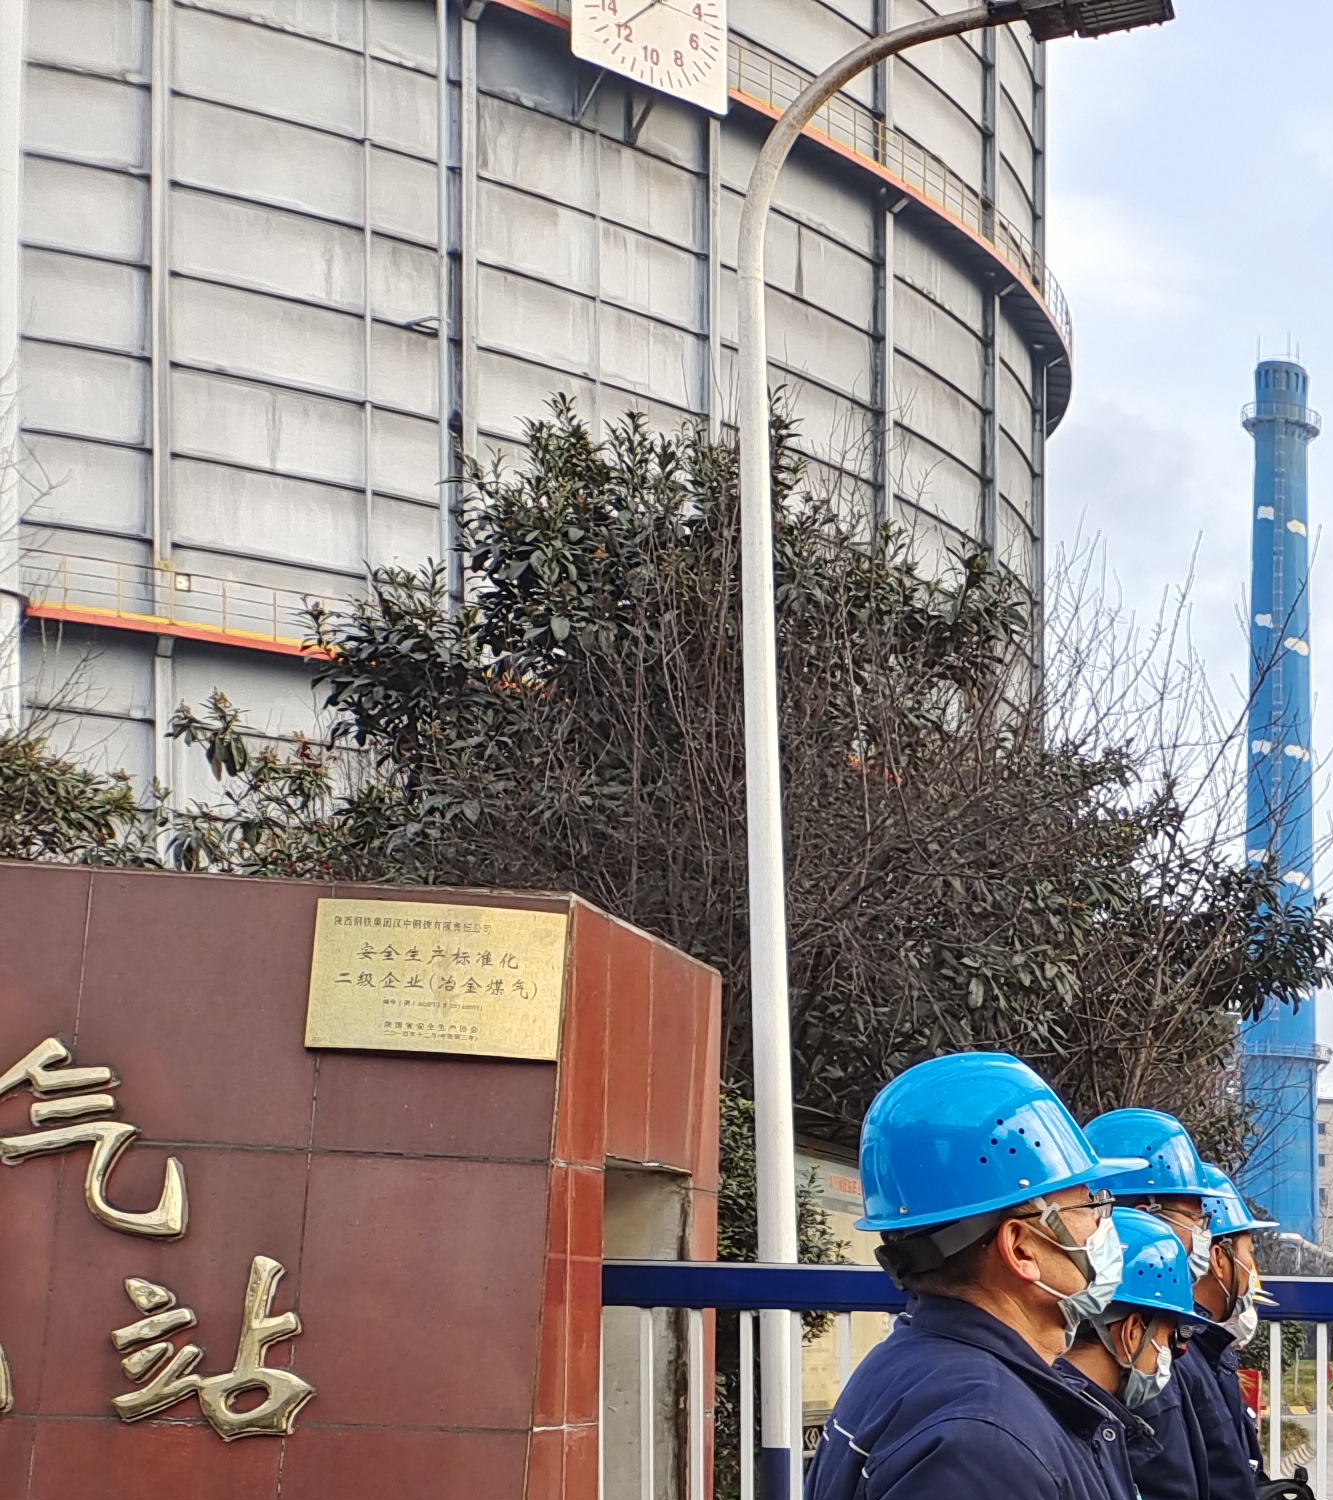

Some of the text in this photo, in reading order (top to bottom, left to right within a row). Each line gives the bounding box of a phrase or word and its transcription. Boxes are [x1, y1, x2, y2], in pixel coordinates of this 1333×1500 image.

[692, 3, 702, 21] 4
[615, 22, 633, 43] 12
[689, 33, 700, 51] 6
[642, 45, 660, 66] 10
[673, 50, 684, 68] 8
[355, 942, 519, 970] 安全生产标准化
[0, 1037, 190, 1238] 气
[0, 1255, 317, 1442] 站
